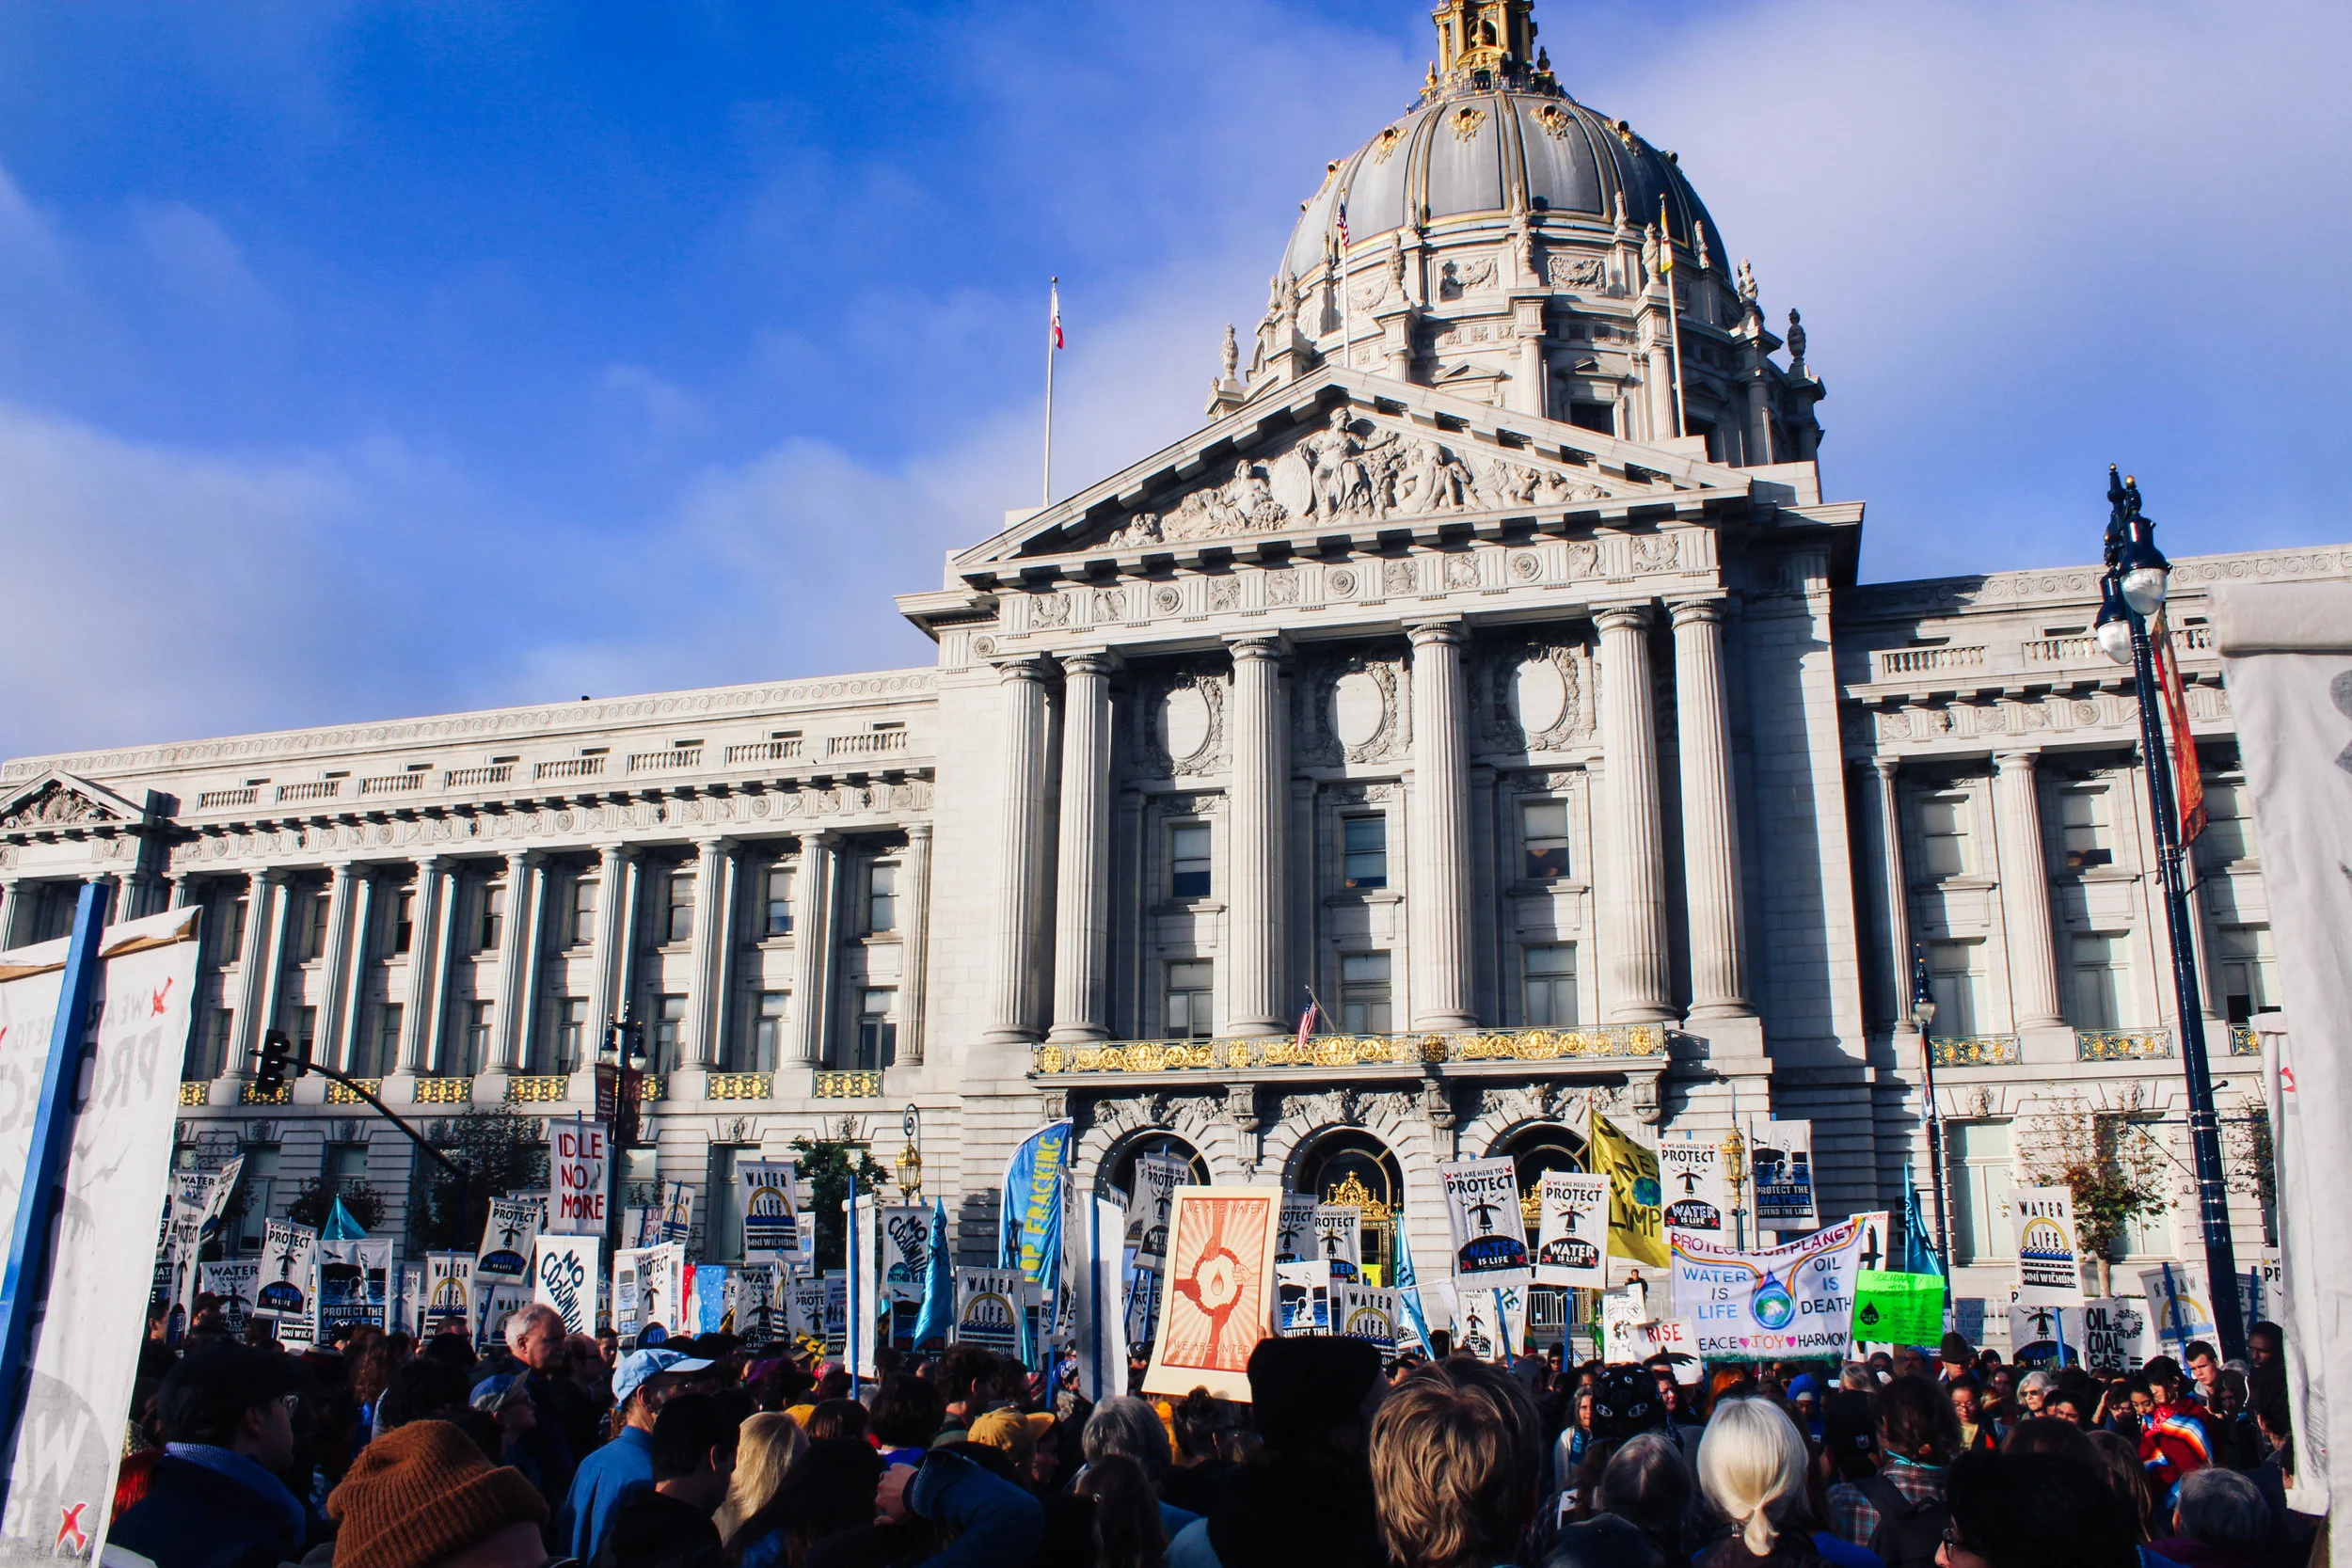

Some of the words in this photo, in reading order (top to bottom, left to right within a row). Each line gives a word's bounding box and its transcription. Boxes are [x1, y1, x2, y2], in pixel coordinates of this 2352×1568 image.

[558, 1132, 603, 1159] IDLE
[1661, 1149, 1715, 1163] PROTECT
[180, 1176, 215, 1186] WATER
[561, 1163, 589, 1190] NO
[745, 1172, 787, 1187] WATER
[1148, 1172, 1184, 1187] PROTECT
[1447, 1174, 1513, 1194] PROTECT
[1546, 1188, 1602, 1201] PROTECT
[1793, 1185, 1809, 1194] THE
[560, 1193, 604, 1220] MORE
[755, 1199, 782, 1214] LIFE
[1757, 1195, 1809, 1204] WATER
[493, 1209, 536, 1223] PROTECT
[1186, 1204, 1200, 1213] WE
[1204, 1204, 1226, 1214] ARE
[1231, 1204, 1264, 1214] WATER
[1671, 1204, 1716, 1218] WATER
[2018, 1201, 2063, 1217] WATER
[906, 1215, 928, 1242] NO
[1314, 1217, 1356, 1227] ROTECT
[268, 1230, 311, 1248] PROTECT
[1790, 1224, 1856, 1255] PLANET
[2031, 1231, 2058, 1247] LIFE
[1470, 1242, 1520, 1257] WATER
[1549, 1243, 1595, 1258] WATER
[1489, 1256, 1509, 1264] LIFE
[1814, 1258, 1841, 1272] OIL
[209, 1266, 259, 1276] WATER
[435, 1263, 468, 1277] WATER
[562, 1249, 584, 1288] NO
[1682, 1266, 1747, 1283] WATER
[741, 1272, 773, 1283] WAT
[967, 1276, 1013, 1294] WATER
[1822, 1276, 1838, 1291] IS
[266, 1286, 301, 1302] WATER
[438, 1290, 459, 1305] LIFE
[796, 1296, 824, 1306] PROTE
[1349, 1292, 1391, 1310] WATER
[1711, 1288, 1728, 1300] IS
[323, 1307, 363, 1316] PROTECT
[367, 1307, 384, 1316] THE
[1698, 1304, 1738, 1320] LIFE
[1801, 1296, 1851, 1315] DEATH
[975, 1306, 1003, 1322] LIFE
[1316, 1327, 1328, 1337] THE
[1357, 1319, 1383, 1334] LIFE
[1645, 1323, 1683, 1343] RISE
[1174, 1340, 1188, 1351] WE
[1192, 1342, 1213, 1353] ARE
[1217, 1343, 1250, 1354] UNITED
[1697, 1337, 1738, 1352] EACE
[1750, 1335, 1785, 1349] JOY
[1798, 1332, 1848, 1348] HARMON
[2090, 1354, 2121, 1368] GAS
